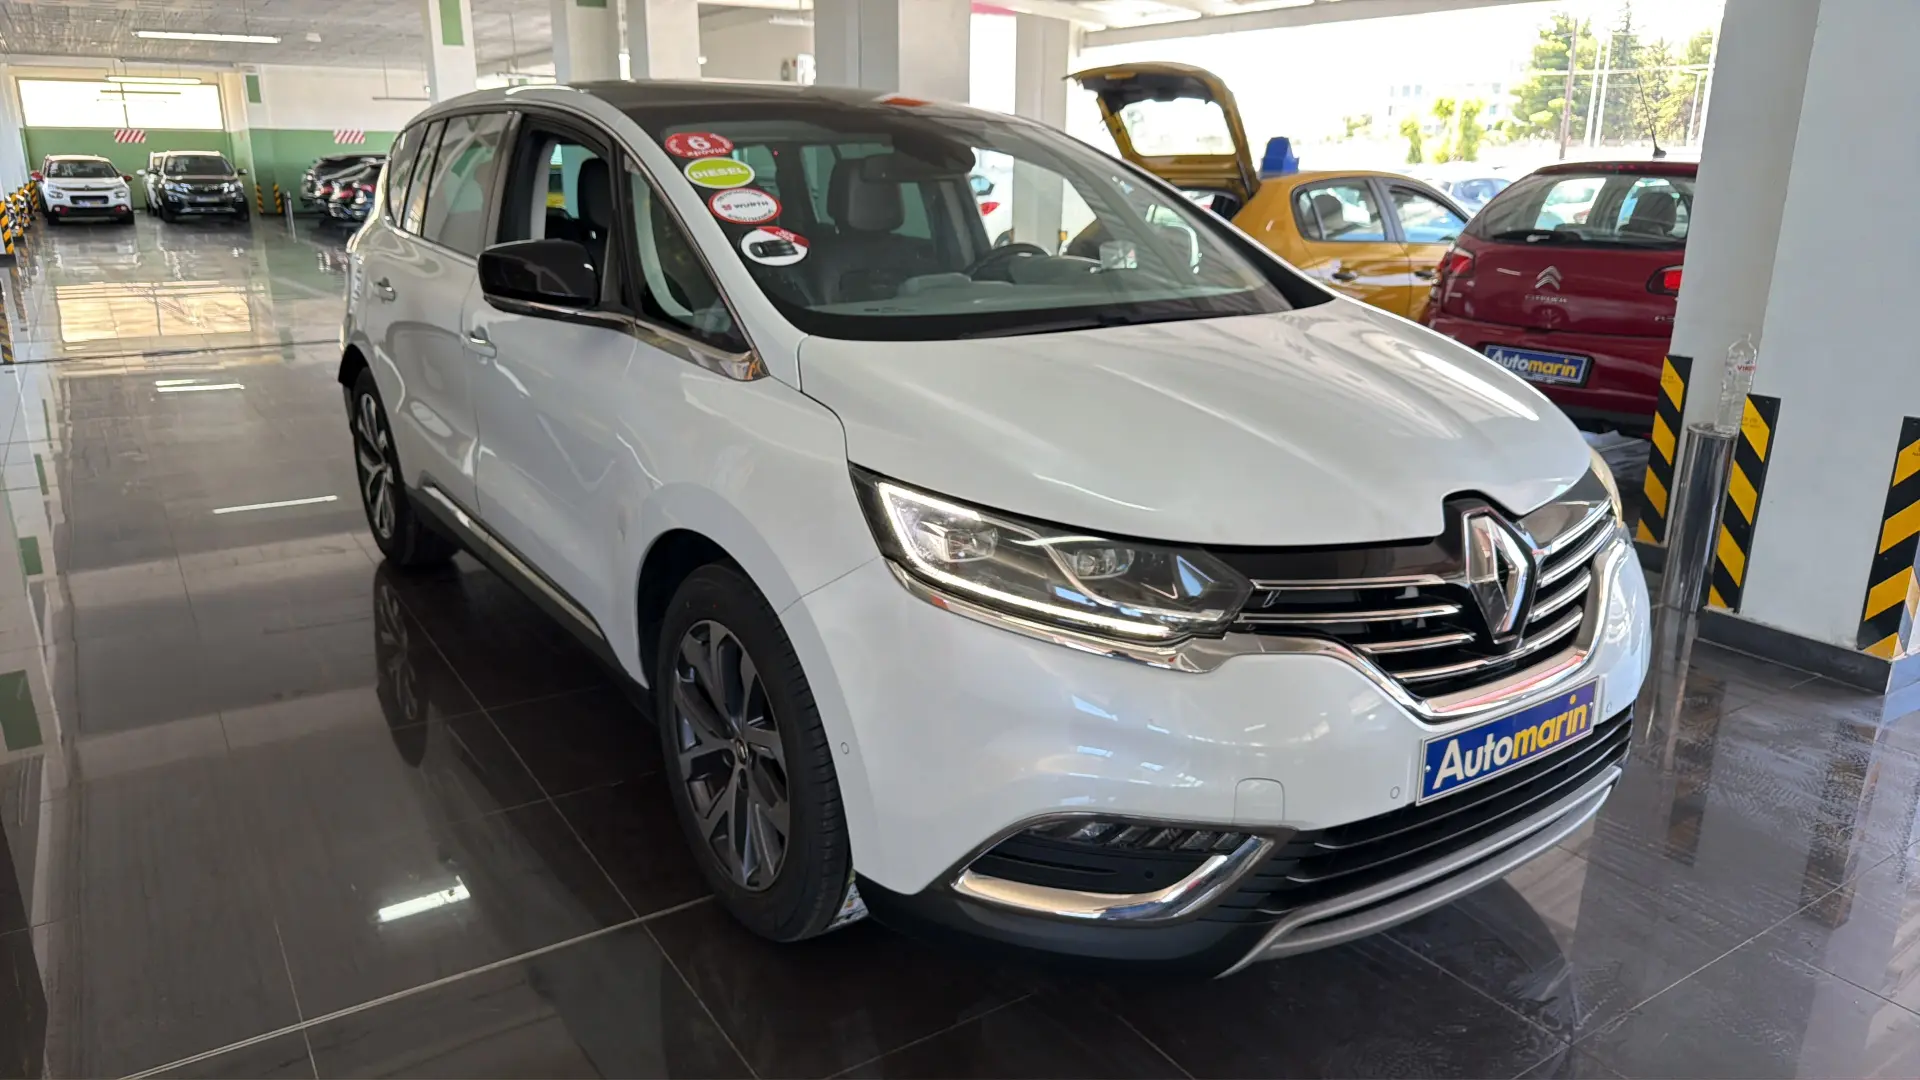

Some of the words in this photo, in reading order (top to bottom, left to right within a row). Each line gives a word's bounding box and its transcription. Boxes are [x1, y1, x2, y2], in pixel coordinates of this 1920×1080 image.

[687, 135, 712, 150] 6
[690, 166, 749, 180] DIESEL
[1491, 349, 1577, 378] Automarin
[1432, 693, 1588, 790] Automarin
